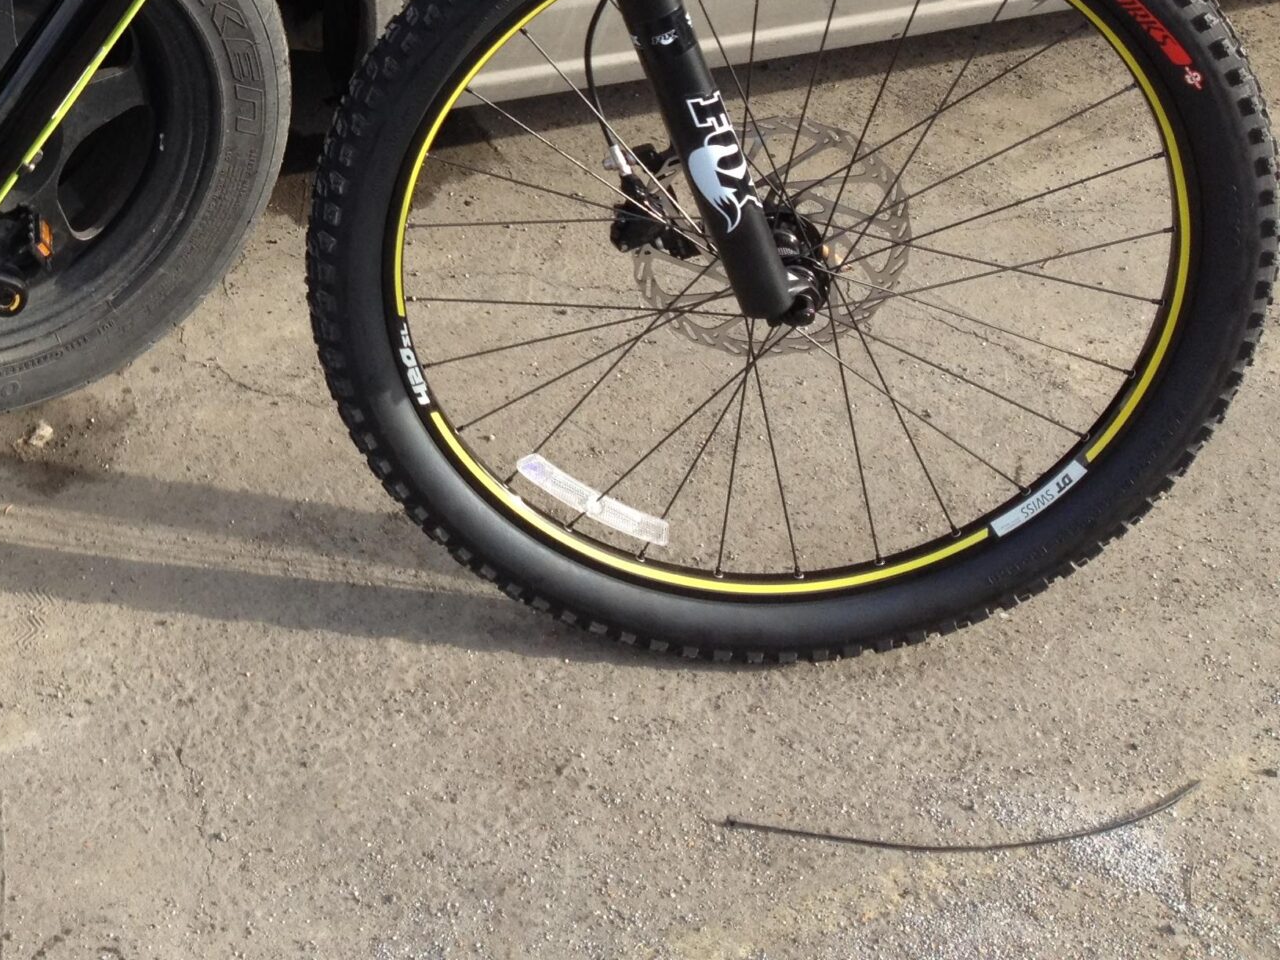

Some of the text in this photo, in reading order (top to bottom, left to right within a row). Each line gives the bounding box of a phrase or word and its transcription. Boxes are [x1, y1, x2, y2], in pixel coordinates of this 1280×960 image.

[686, 89, 763, 220] FOX
[1020, 473, 1074, 519] DT SWISS
